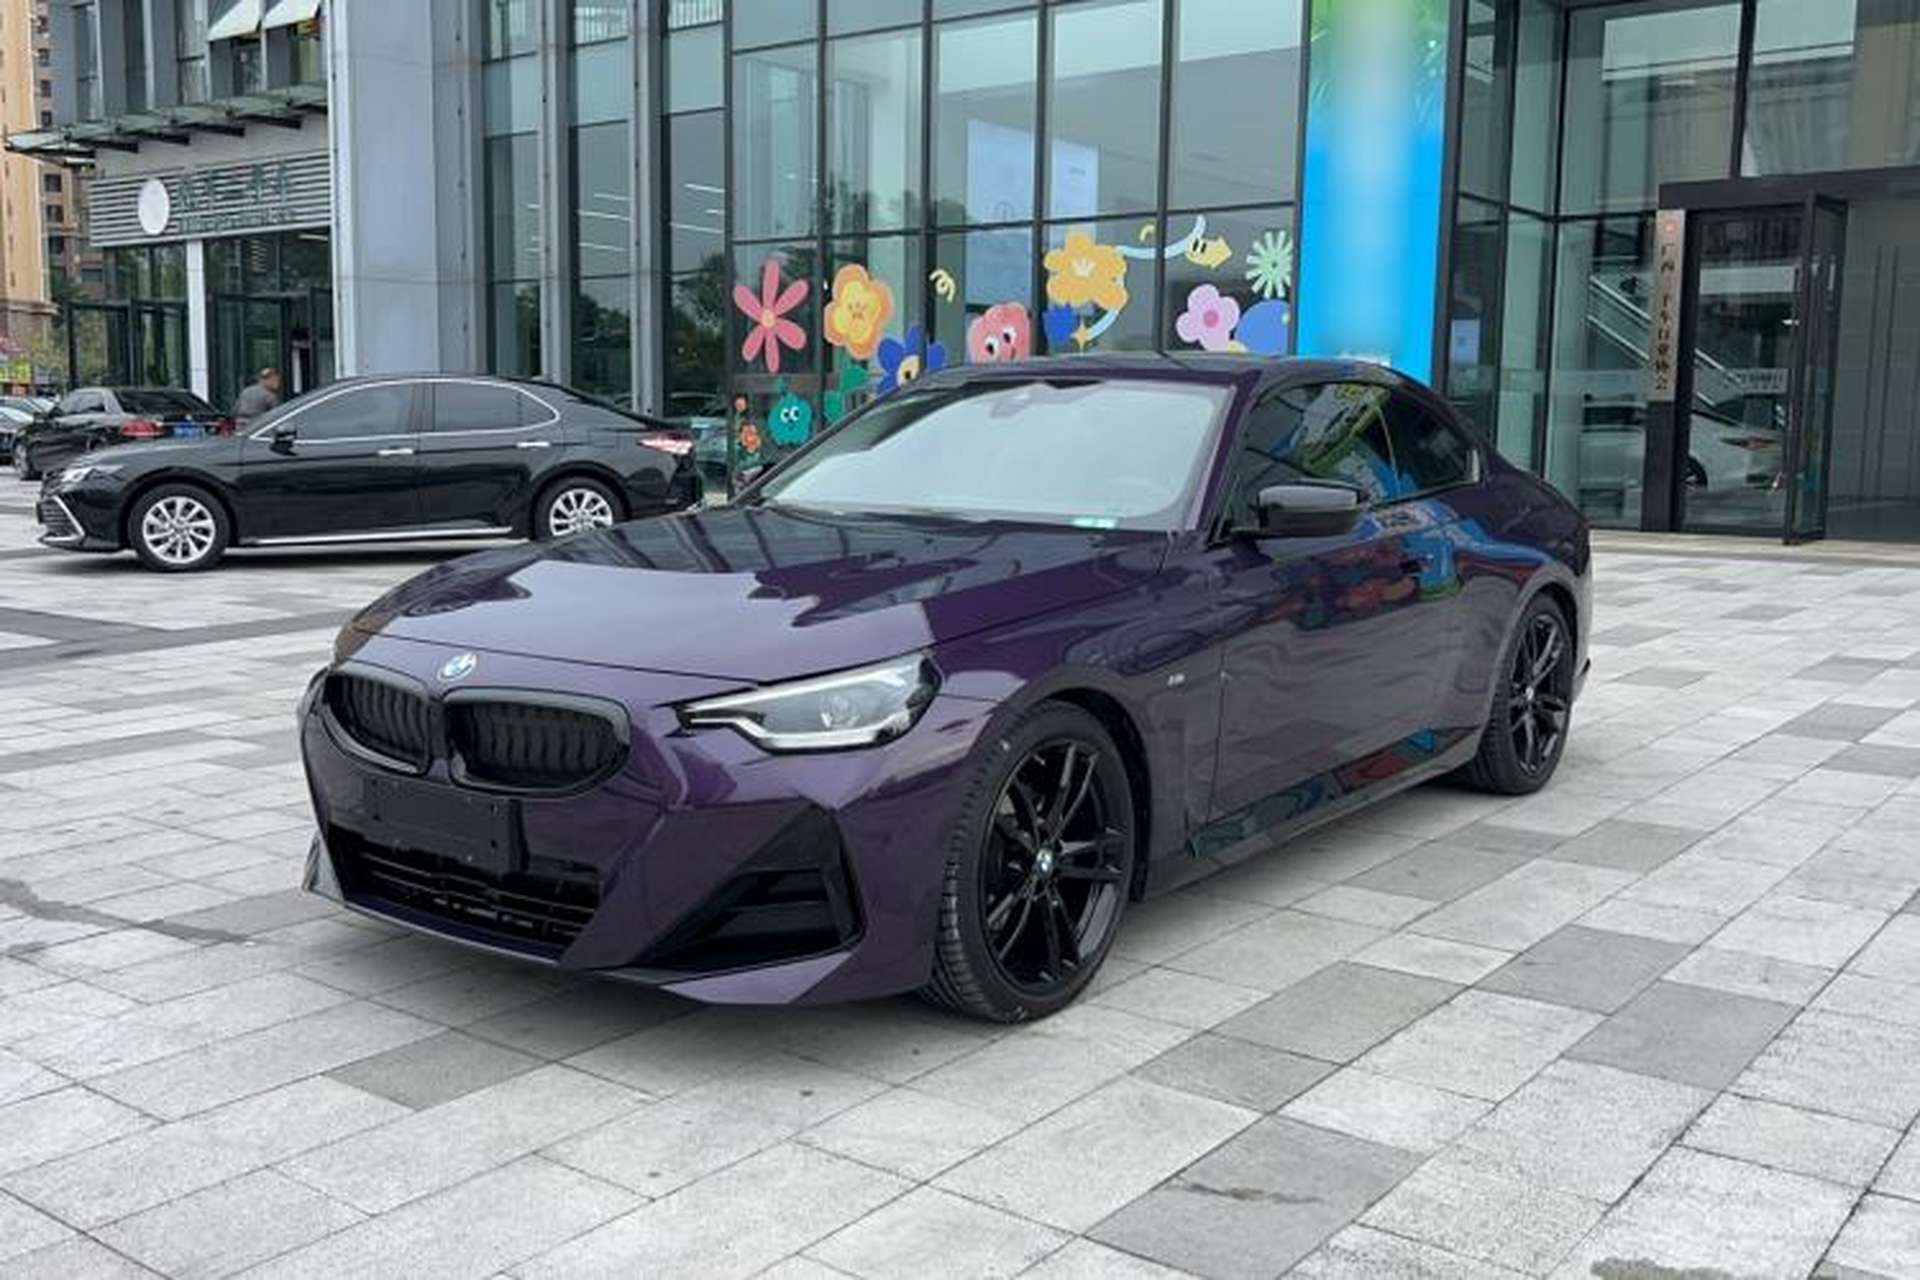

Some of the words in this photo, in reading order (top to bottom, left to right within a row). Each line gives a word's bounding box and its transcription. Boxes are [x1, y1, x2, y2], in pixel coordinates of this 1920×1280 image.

[1655, 244, 1676, 391] 广西手车行业协会
